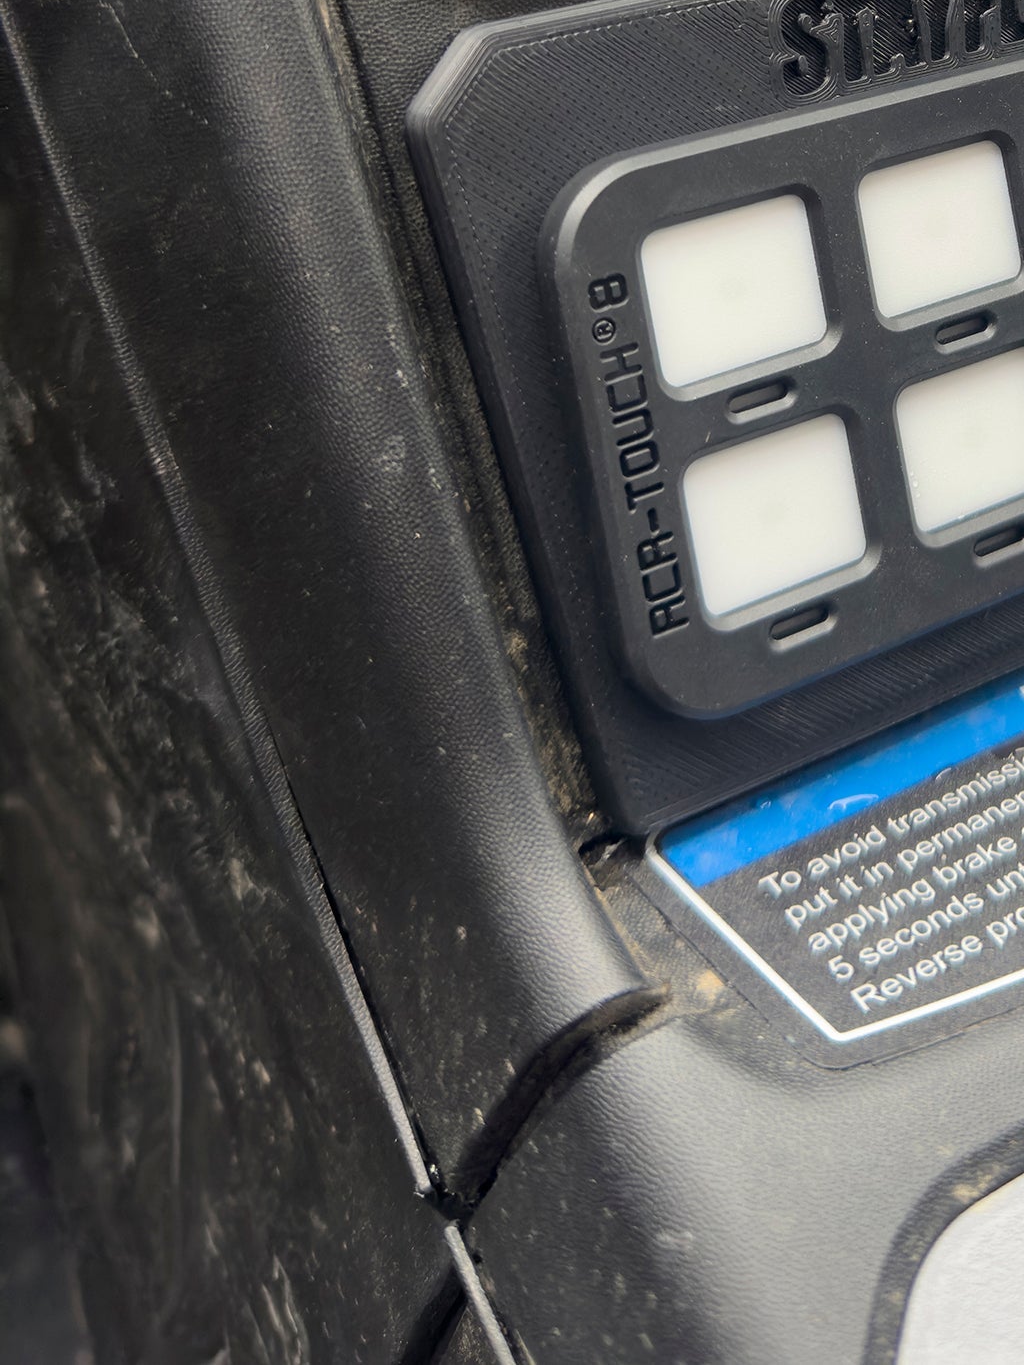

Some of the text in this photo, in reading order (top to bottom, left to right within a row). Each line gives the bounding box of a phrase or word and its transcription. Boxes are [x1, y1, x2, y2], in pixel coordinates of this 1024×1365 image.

[588, 273, 629, 311] 8
[759, 871, 801, 897] To
[807, 825, 886, 877] avoid
[784, 887, 838, 928] put
[836, 874, 862, 897] it
[861, 860, 893, 884] in
[808, 878, 936, 953] applying
[932, 834, 1017, 884] brake
[828, 955, 854, 979] 5
[859, 891, 984, 965] seconds
[851, 934, 983, 1012] Reverse
